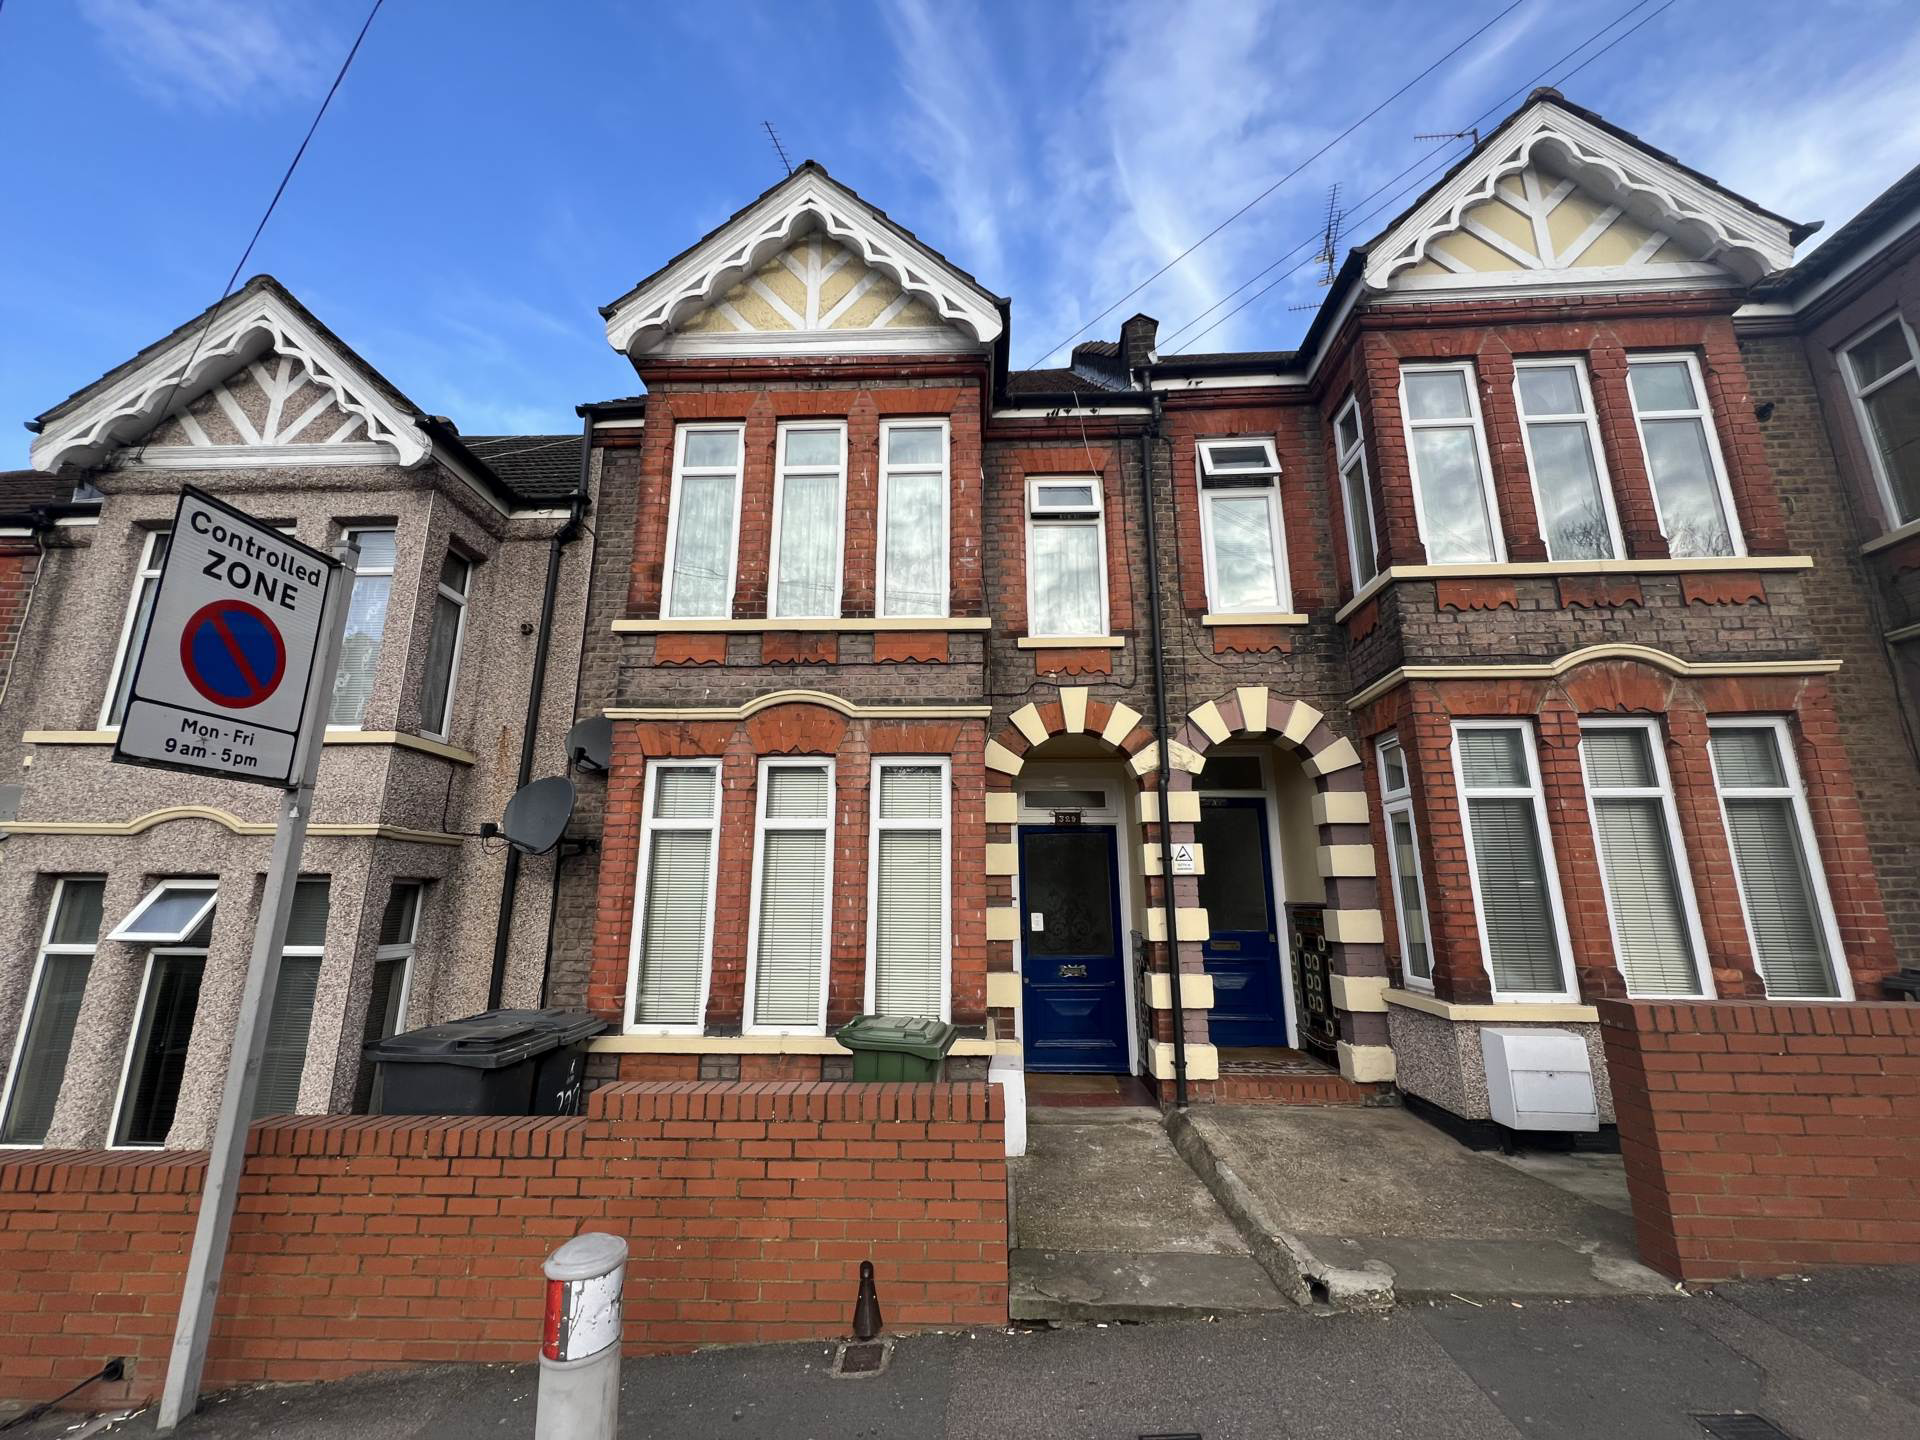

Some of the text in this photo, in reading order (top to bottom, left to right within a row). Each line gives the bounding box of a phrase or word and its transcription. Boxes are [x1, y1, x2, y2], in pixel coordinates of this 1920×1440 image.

[190, 510, 322, 588] Controlled
[202, 548, 298, 611] ZONE
[180, 717, 219, 739] Mon
[233, 729, 255, 746] Fri
